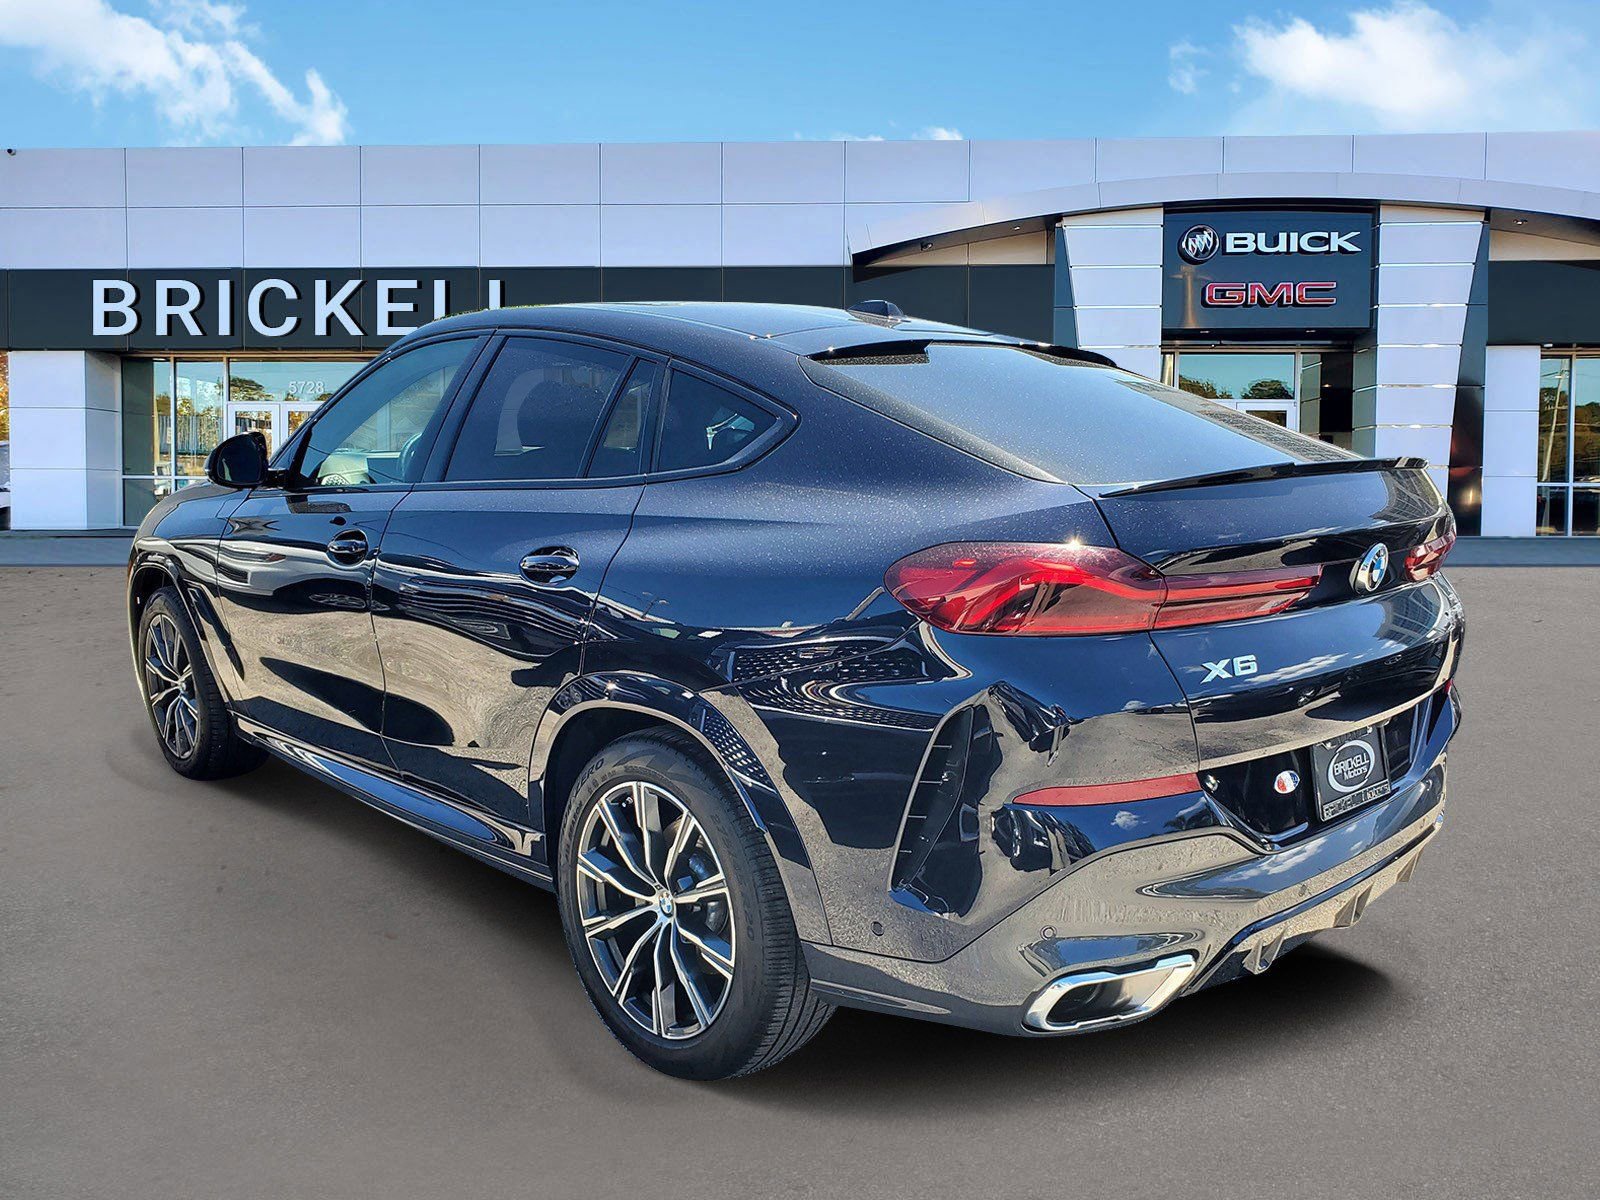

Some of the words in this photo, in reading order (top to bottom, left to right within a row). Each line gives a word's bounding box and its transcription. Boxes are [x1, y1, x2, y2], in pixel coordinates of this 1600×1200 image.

[1226, 231, 1362, 253] BUICK
[1206, 281, 1337, 305] GMC
[289, 380, 324, 394] 5728
[1200, 654, 1258, 684] X6
[1333, 752, 1370, 776] BRICKELL
[1343, 765, 1368, 781] Motors
